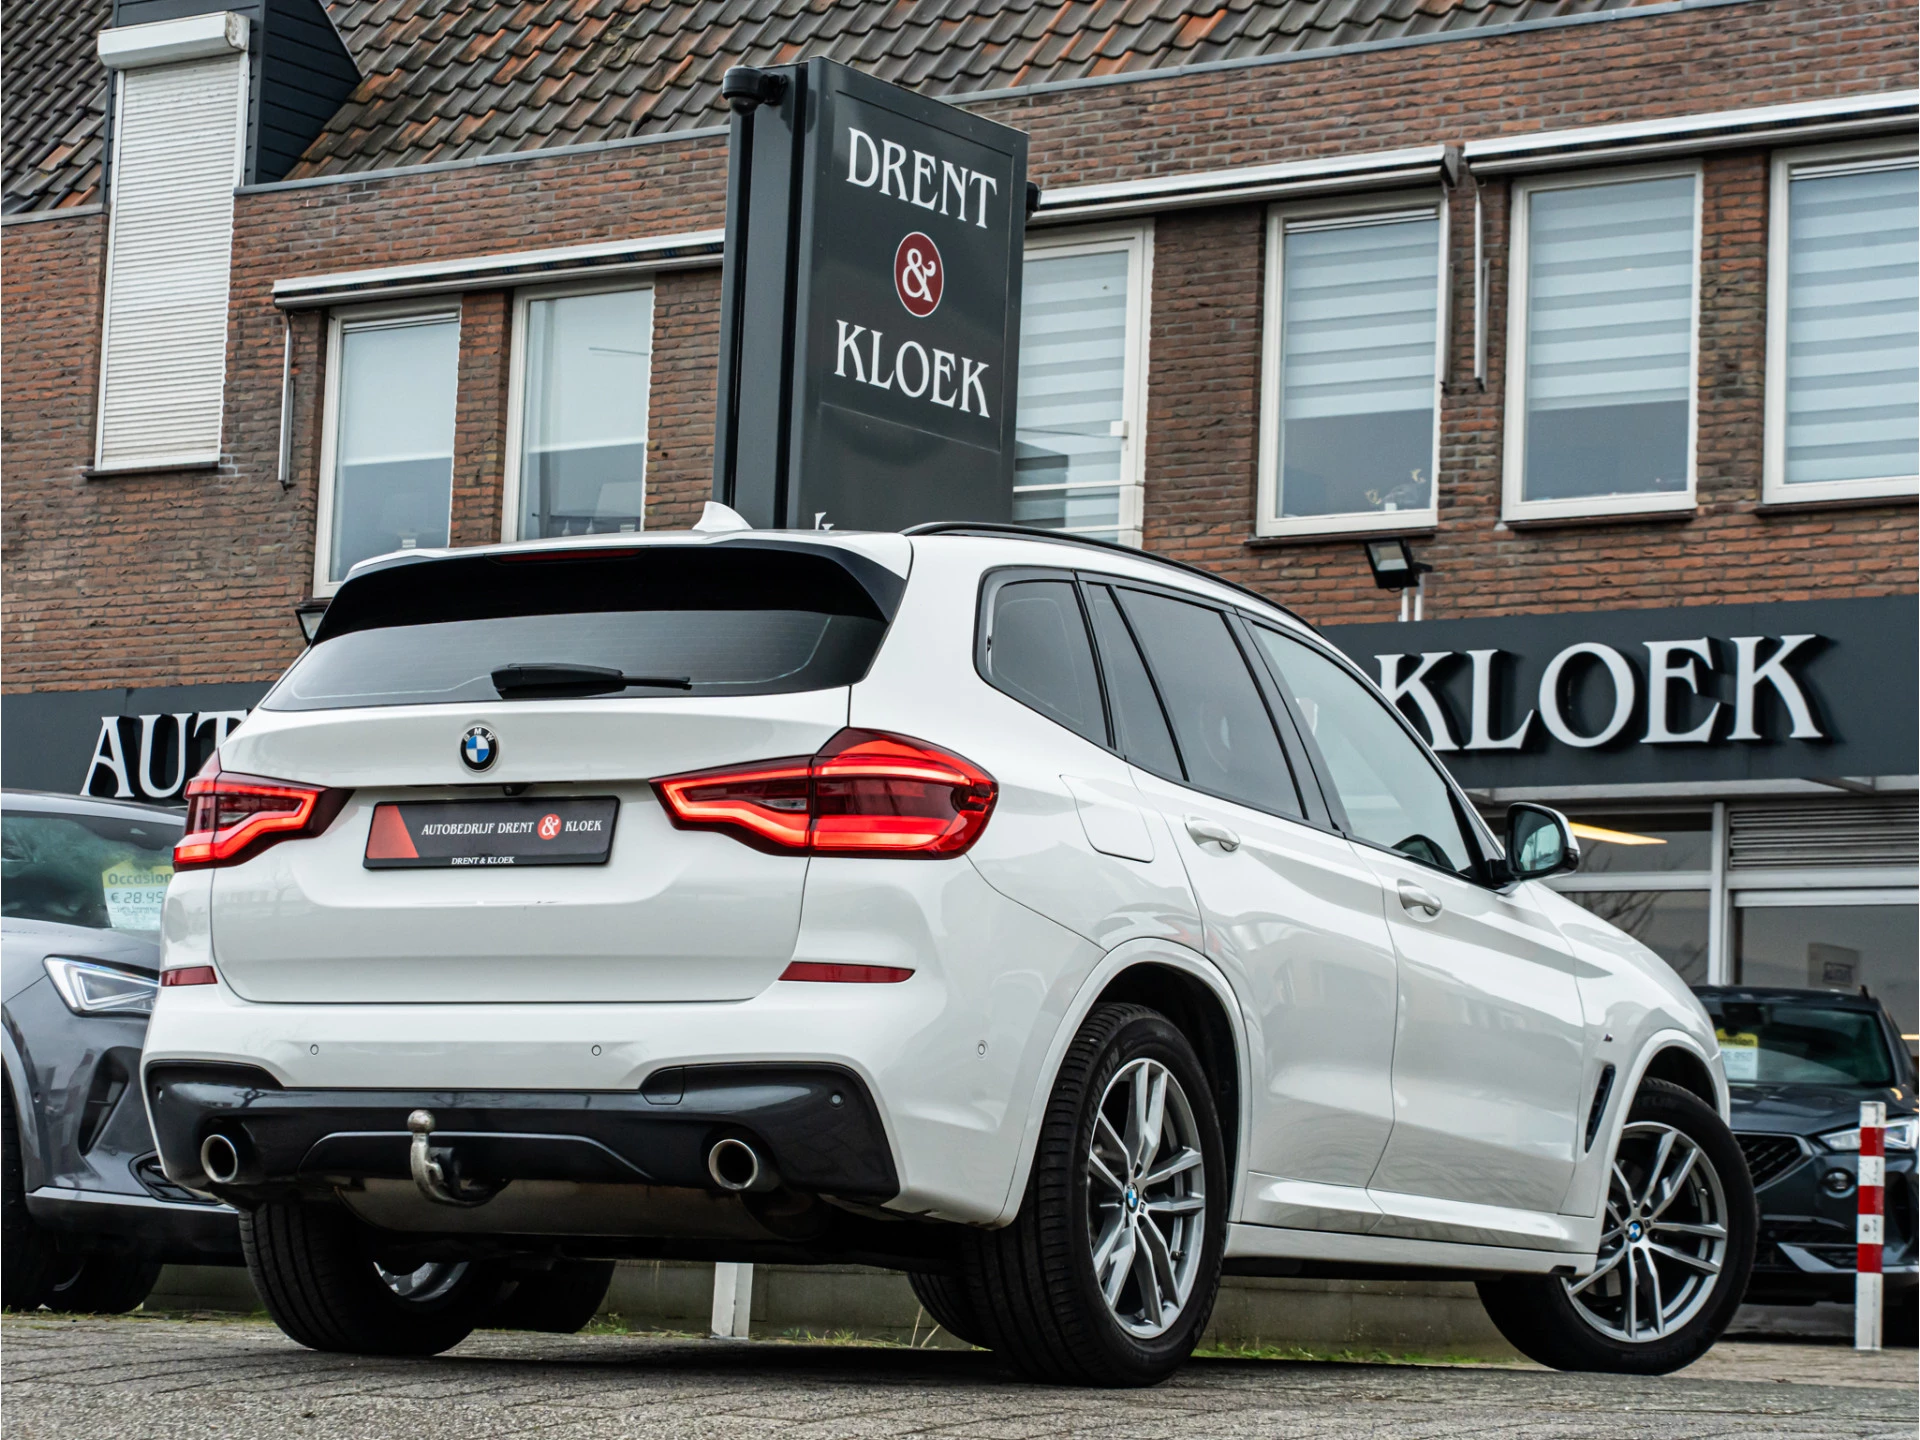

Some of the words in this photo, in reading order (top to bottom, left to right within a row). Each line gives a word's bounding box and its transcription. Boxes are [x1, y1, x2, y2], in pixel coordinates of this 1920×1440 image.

[846, 126, 998, 229] DRENT
[901, 247, 936, 303] &
[834, 319, 990, 419] KLOEK
[1373, 633, 1825, 752] KLOEK
[463, 727, 495, 742] BMW
[421, 822, 496, 836] AUTOBEDRIJF
[497, 821, 535, 834] DRENT
[541, 816, 559, 836] &
[565, 819, 603, 832] KLOEK
[450, 856, 480, 865] DRENT
[479, 856, 487, 865] &
[487, 856, 515, 864] KLOEK
[107, 872, 173, 885] Occasion
[111, 891, 120, 904] €
